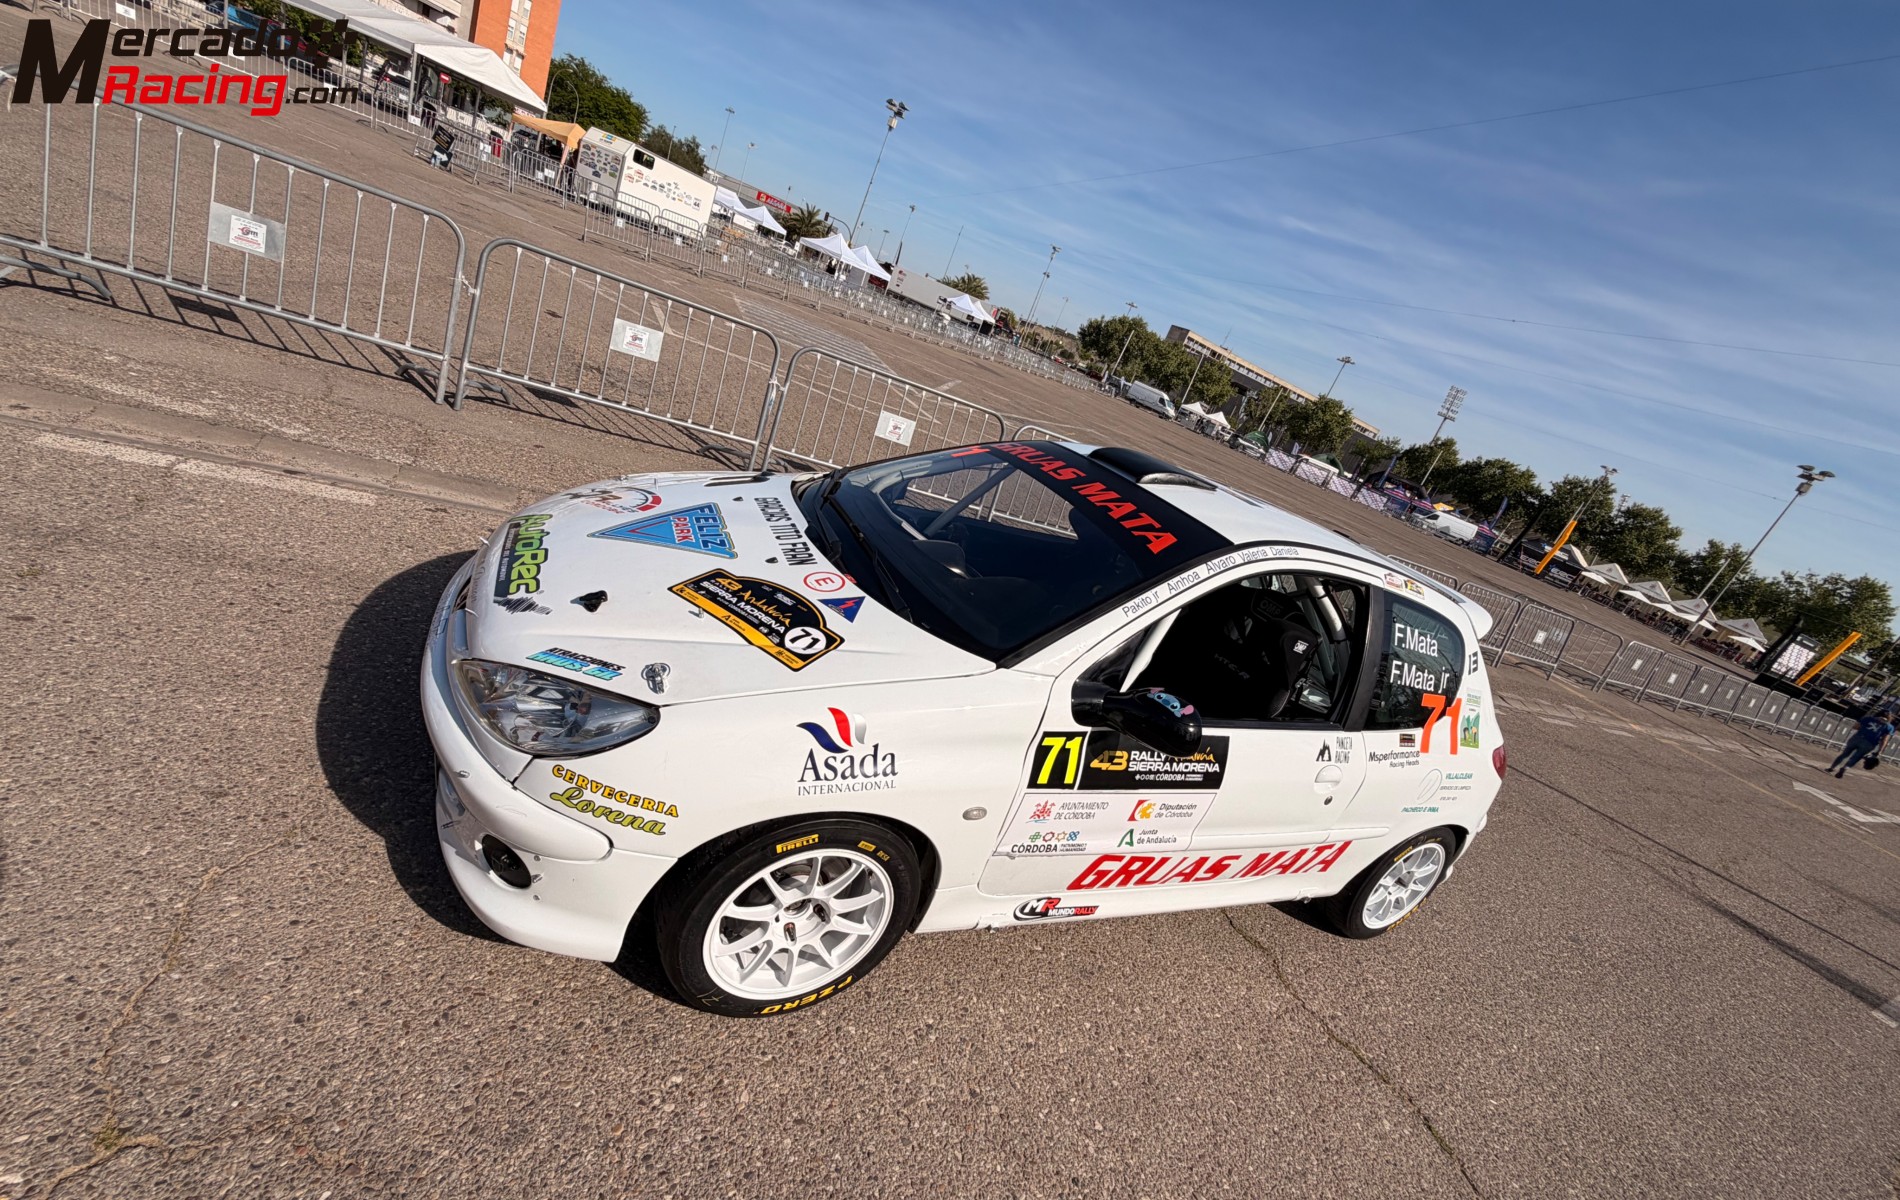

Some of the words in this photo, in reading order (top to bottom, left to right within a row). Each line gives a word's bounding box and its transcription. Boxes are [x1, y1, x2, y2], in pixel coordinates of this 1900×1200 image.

[990, 442, 1088, 481] GRUAS
[1071, 481, 1178, 555] MATA
[672, 516, 695, 543] PARK
[693, 504, 729, 550] FELIZ
[769, 523, 803, 541] TITO
[778, 541, 818, 566] FRAN
[715, 578, 743, 590] 43
[814, 576, 836, 587] E
[1122, 592, 1153, 617] Pakito
[1153, 590, 1160, 604] jr
[1167, 570, 1201, 595] Ainhoa
[1238, 547, 1268, 563] Valeria
[1270, 546, 1299, 556] Daniela
[700, 581, 738, 604] SIERRA
[737, 601, 785, 634] MORENA
[788, 628, 822, 651] 71
[1394, 622, 1438, 658] F.Mata
[1389, 659, 1435, 692] F.Mata
[1438, 666, 1450, 693] jr
[1420, 692, 1463, 755] 71
[797, 743, 899, 782] Asada
[1037, 736, 1083, 785] 71
[1089, 750, 1129, 771] 43
[1130, 750, 1167, 761] RALLY
[1128, 762, 1171, 772] SIERRA
[1171, 763, 1220, 773] MORENA
[1369, 749, 1420, 764] Msperformance
[797, 780, 897, 796] INTERNACIONAL
[1156, 773, 1185, 781] CÓRDOBA
[551, 764, 679, 818] CERVECERIA
[549, 786, 667, 836] Lorena
[1053, 811, 1064, 820] DE
[1059, 801, 1109, 811] AYUNTAMIENTO
[1159, 803, 1197, 811] Diputación
[776, 833, 820, 854] PIRELLI
[1011, 842, 1058, 854] CÓRDOBA
[1145, 834, 1177, 844] Andalucía
[1066, 854, 1243, 891] GRUAS
[1231, 840, 1351, 879] MATA
[1023, 897, 1062, 914] MR
